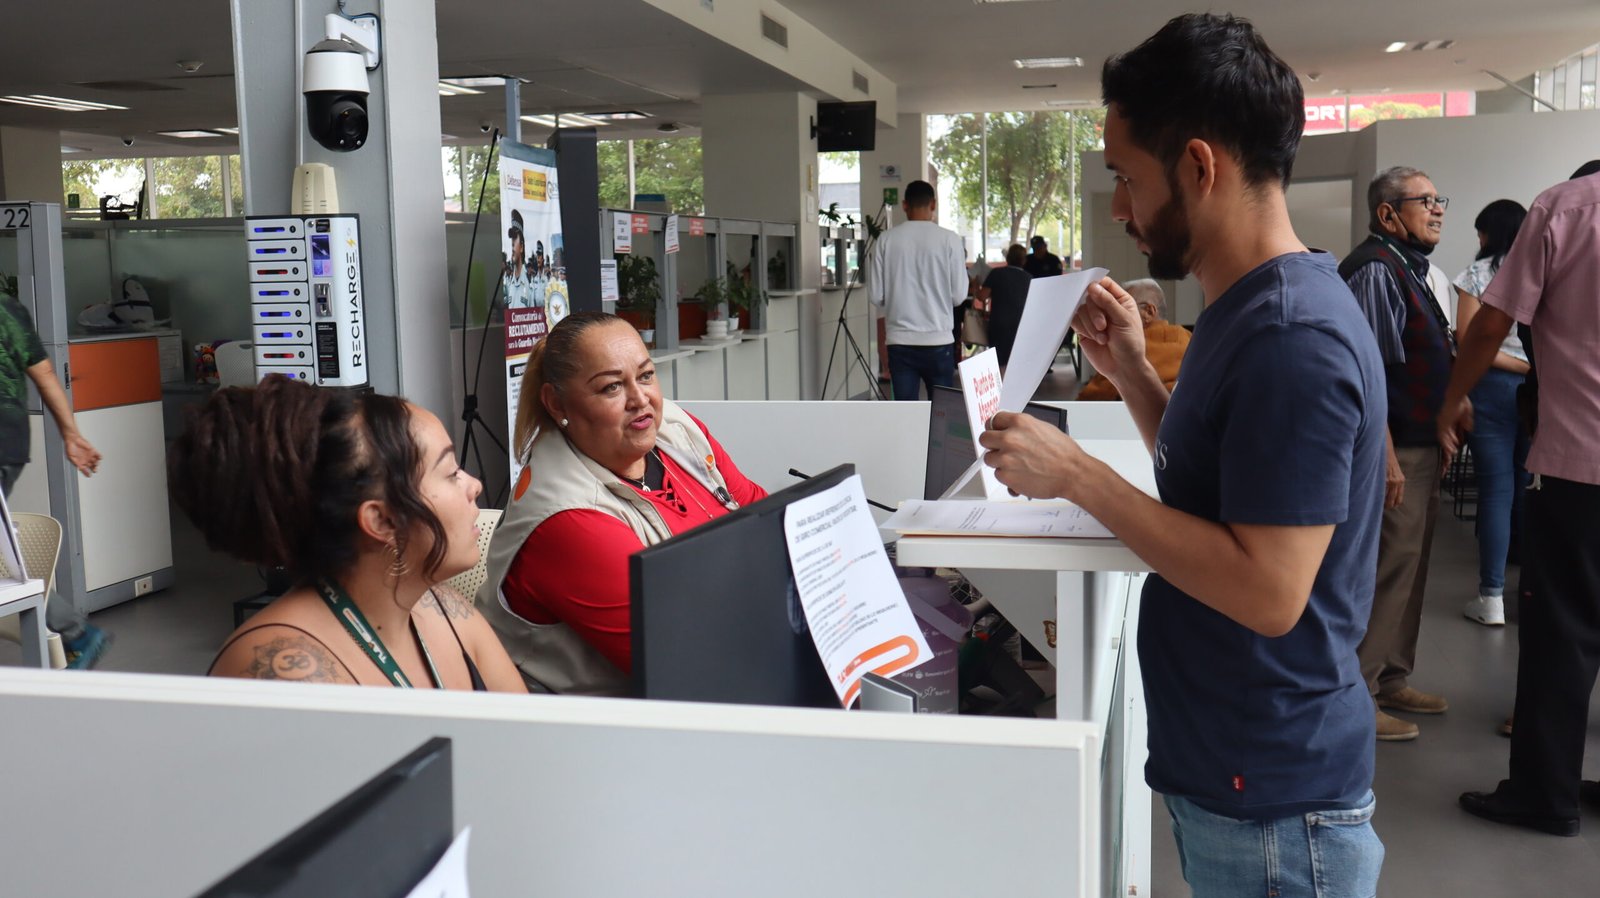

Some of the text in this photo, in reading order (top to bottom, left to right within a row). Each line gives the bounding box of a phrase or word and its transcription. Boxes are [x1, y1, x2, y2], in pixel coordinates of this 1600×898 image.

[4, 208, 30, 228] 22
[346, 252, 362, 367] RECHARGE
[511, 311, 537, 323] Convocatoria
[508, 322, 545, 338] RECLUTAMIENTO
